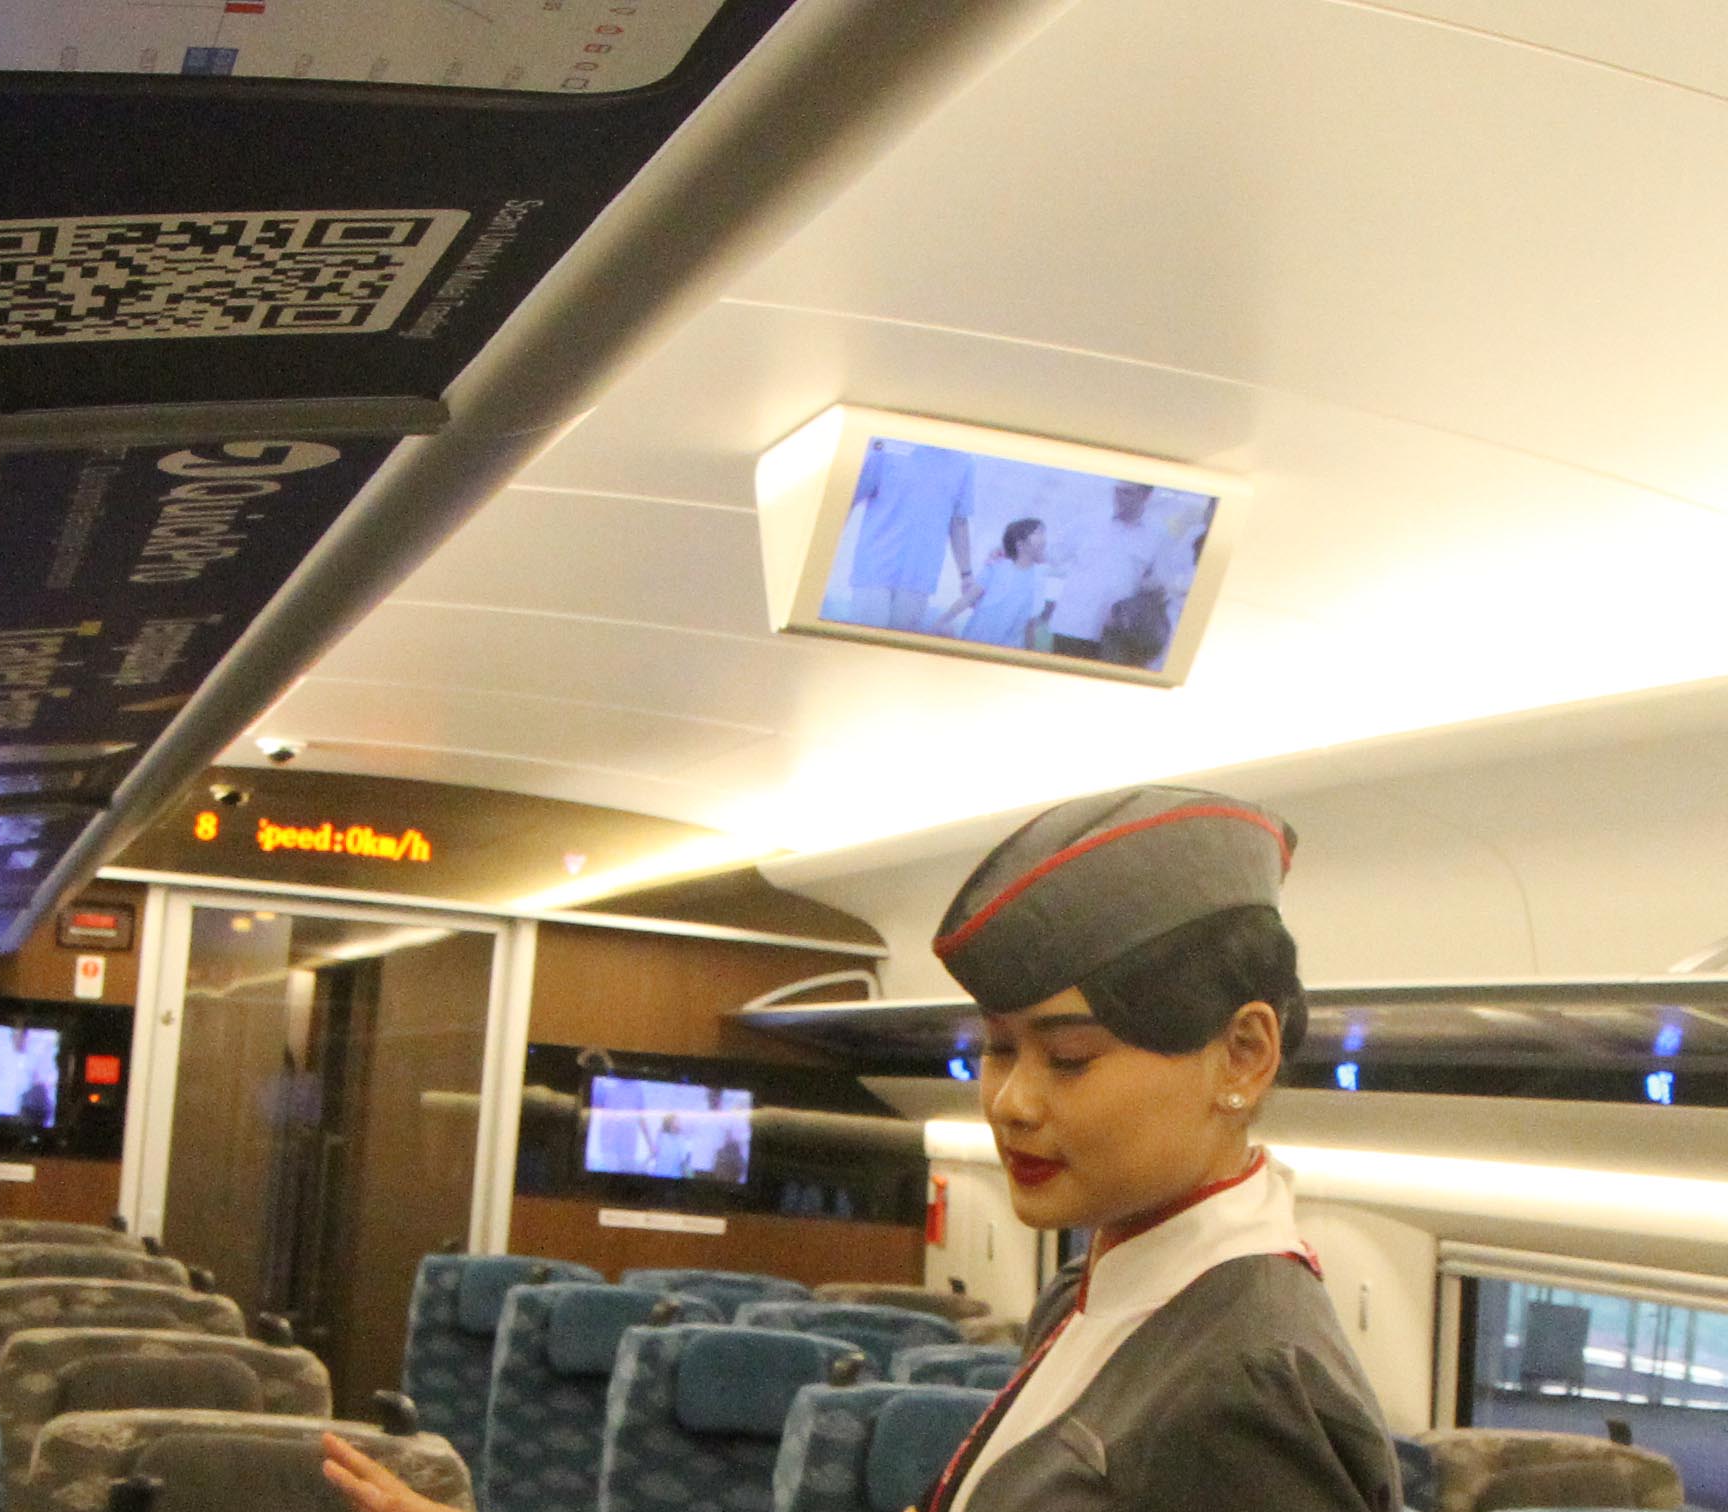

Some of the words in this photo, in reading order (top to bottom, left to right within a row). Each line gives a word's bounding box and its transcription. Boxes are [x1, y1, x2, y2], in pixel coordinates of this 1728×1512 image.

[487, 199, 544, 230] Scan
[129, 479, 282, 583] QuickPro
[195, 811, 219, 841] 8
